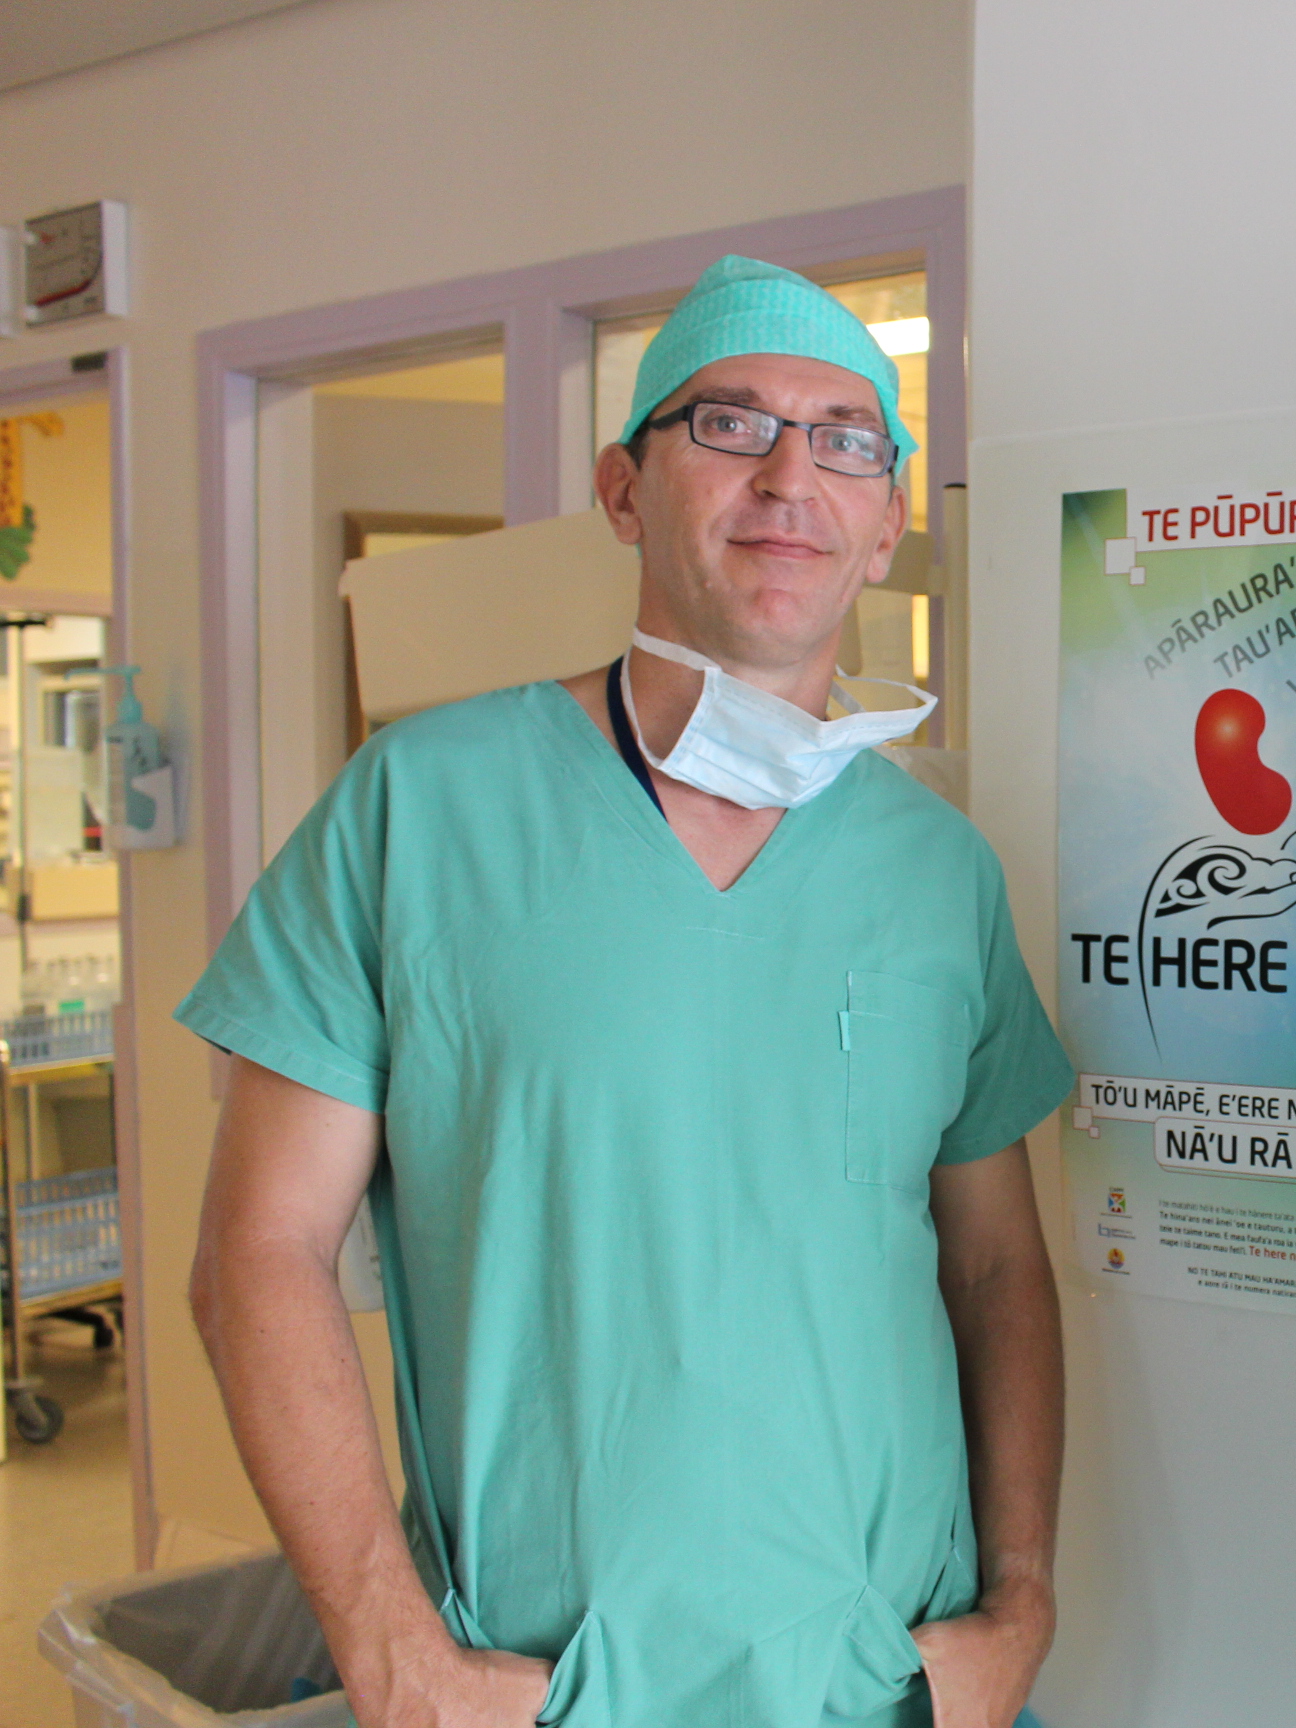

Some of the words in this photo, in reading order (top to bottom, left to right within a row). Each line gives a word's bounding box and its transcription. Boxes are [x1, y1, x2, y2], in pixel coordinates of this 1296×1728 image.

[1142, 507, 1180, 543] TE
[1071, 933, 1130, 986] TE
[1152, 936, 1289, 994] HERE
[1091, 1080, 1138, 1108] TŌ'U
[1144, 1085, 1211, 1117] MĀPĒ,
[1218, 1093, 1279, 1120] E'ERE
[1166, 1125, 1238, 1165] NĀ'U
[1250, 1132, 1293, 1169] RĀ
[1249, 1245, 1261, 1257] Te
[1264, 1246, 1287, 1260] here
